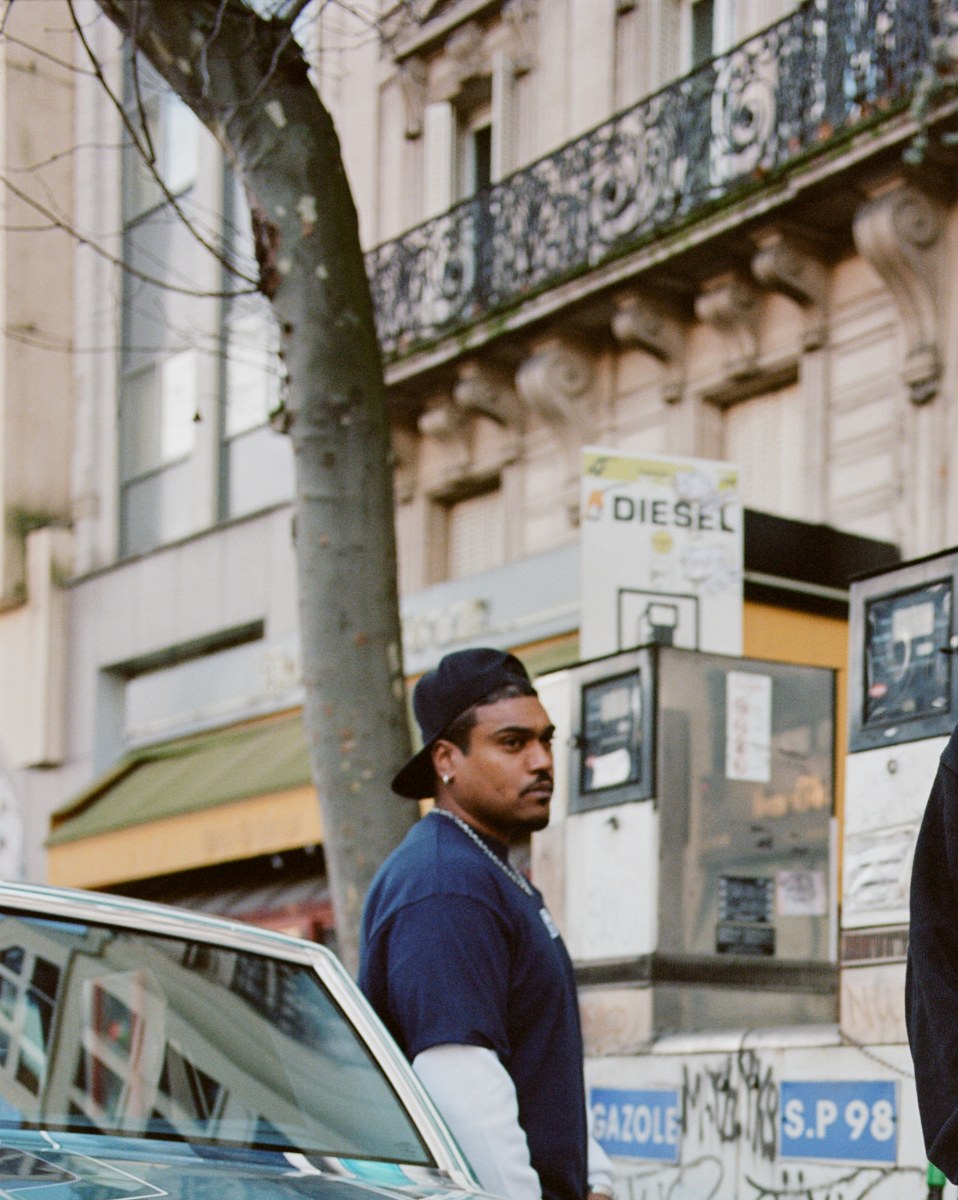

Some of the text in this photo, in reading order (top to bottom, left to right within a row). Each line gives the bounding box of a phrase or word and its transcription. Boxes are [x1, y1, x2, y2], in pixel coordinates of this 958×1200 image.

[613, 495, 734, 533] DIESEL
[592, 1103, 677, 1145] GAZOLE
[845, 1099, 894, 1142] 98
